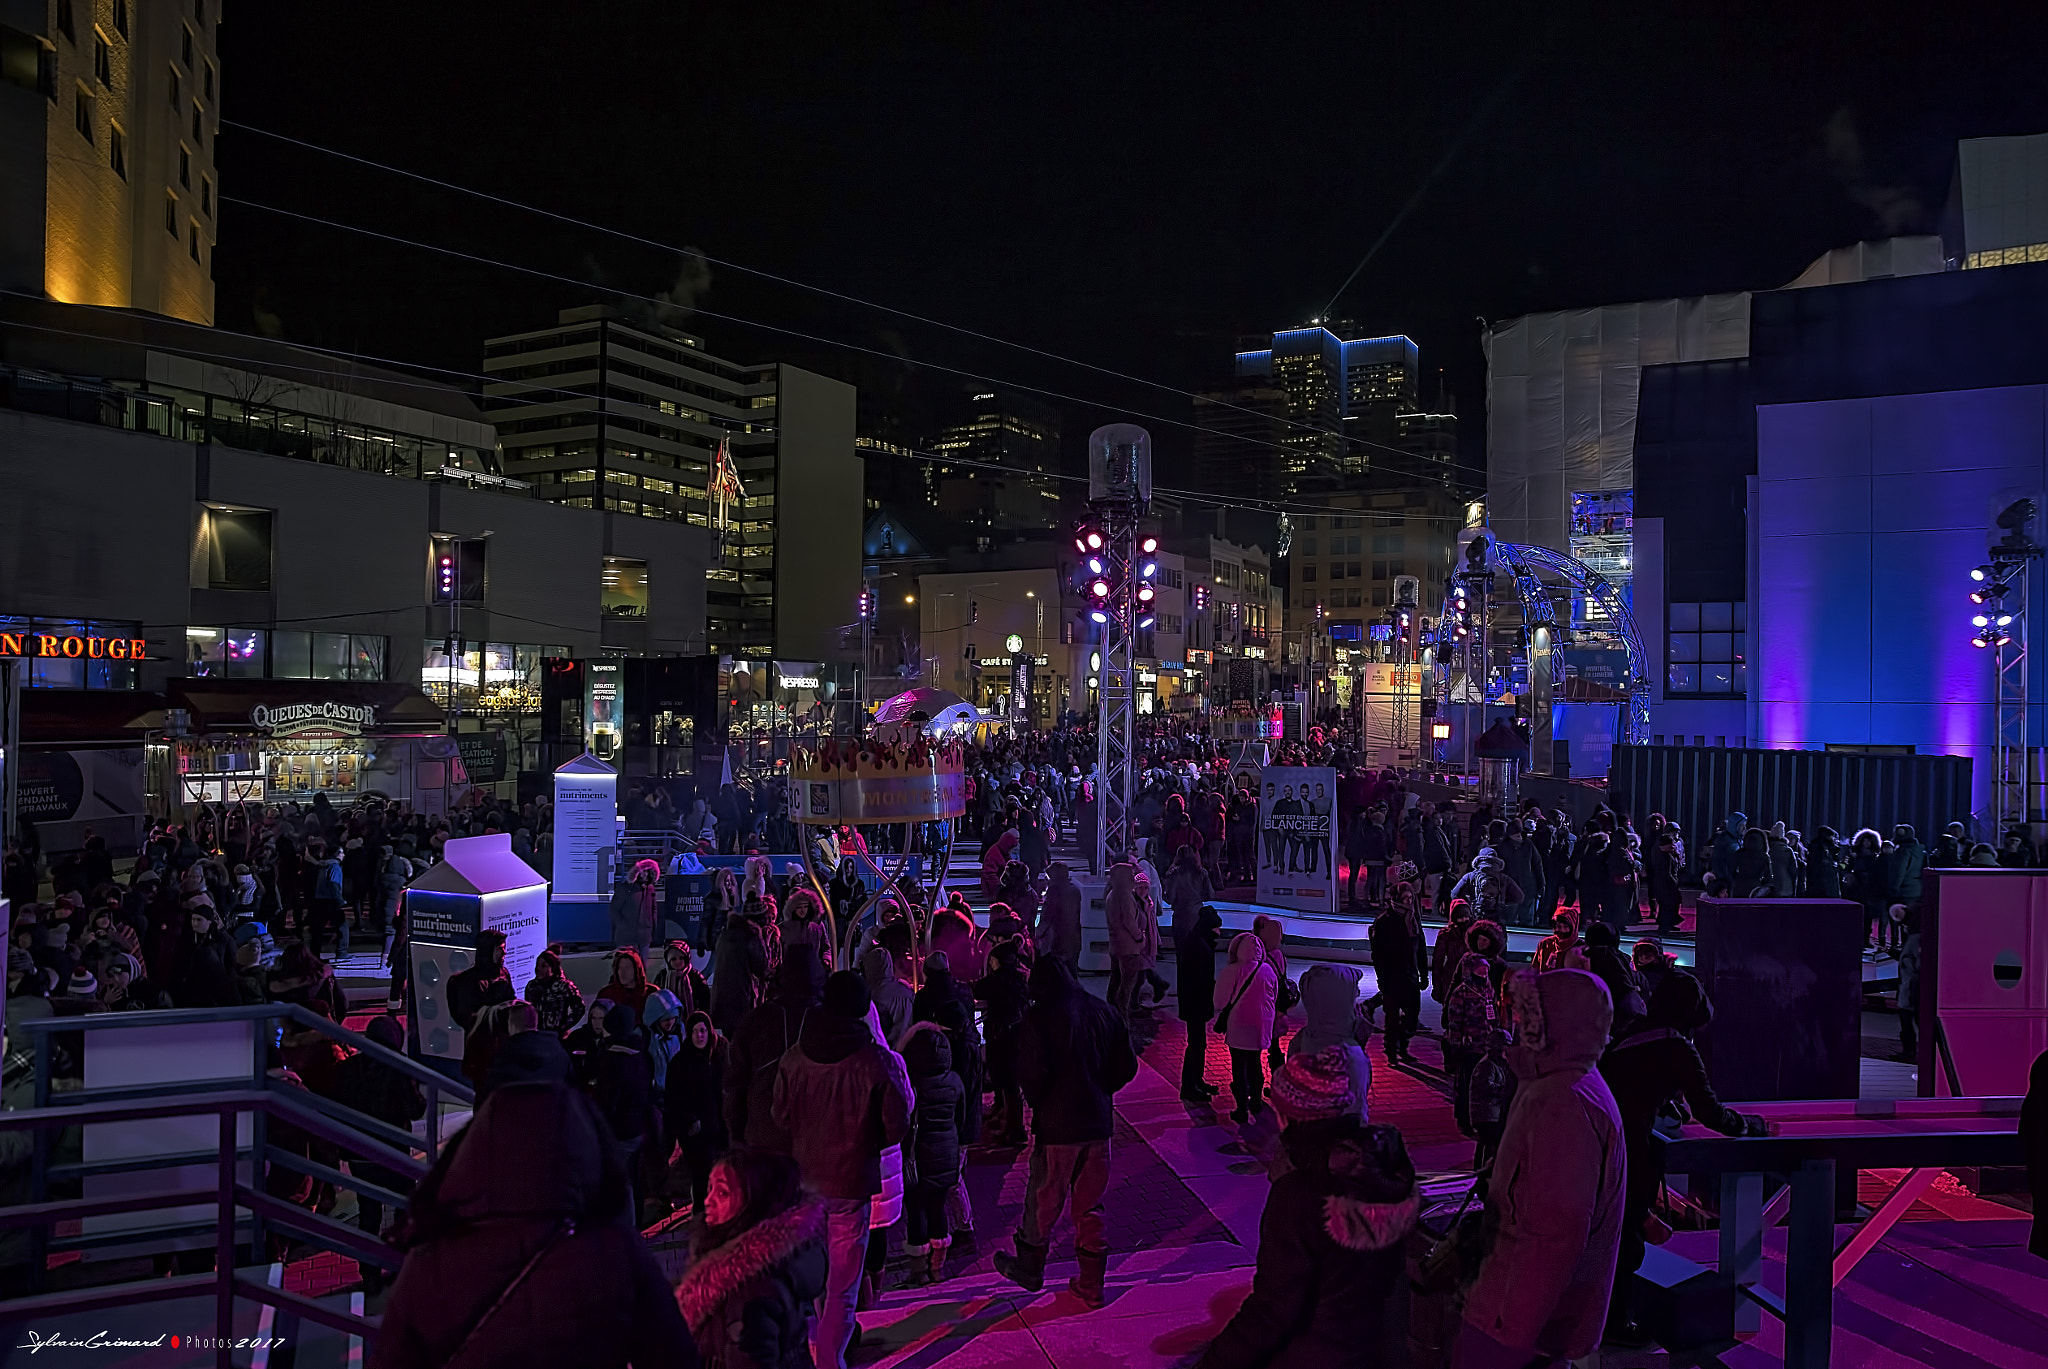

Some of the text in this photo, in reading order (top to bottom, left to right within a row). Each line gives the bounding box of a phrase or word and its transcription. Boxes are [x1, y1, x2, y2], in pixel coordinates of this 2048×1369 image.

[38, 635, 146, 660] ROUGE
[981, 657, 1000, 665] CAFÉ
[779, 675, 819, 689] NESPRESSO
[252, 702, 375, 727] QUEUES DE CASTOR
[277, 723, 296, 733] POUTINE
[472, 741, 482, 749] DE
[466, 757, 494, 767] PHASES
[24, 802, 68, 813] TRAVAUX
[812, 805, 828, 814] RBC
[1264, 815, 1330, 831] BLANCHE 2
[675, 904, 685, 912] EN
[413, 918, 472, 934] nutriments
[488, 915, 539, 932] nutriments
